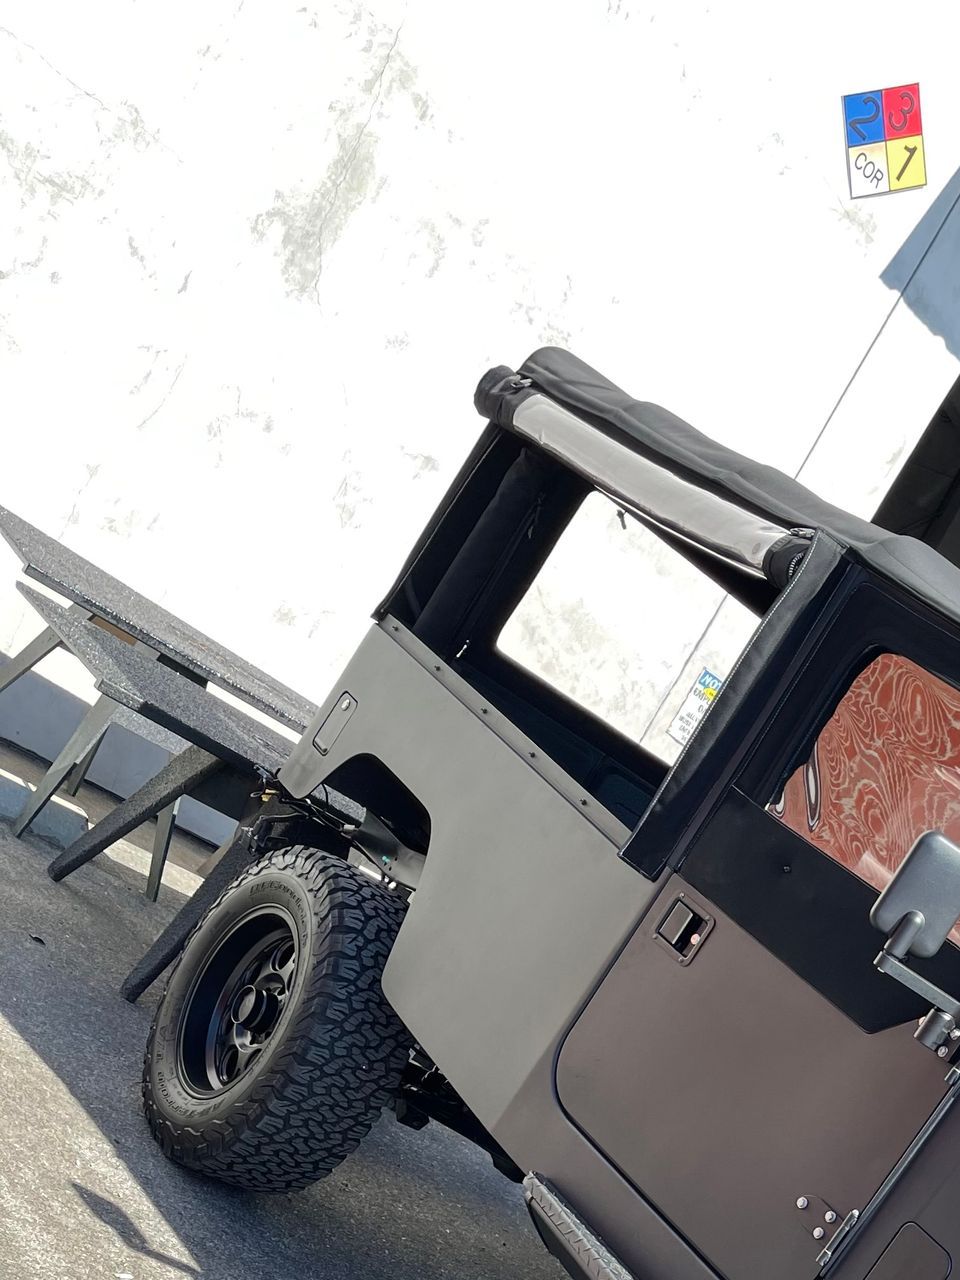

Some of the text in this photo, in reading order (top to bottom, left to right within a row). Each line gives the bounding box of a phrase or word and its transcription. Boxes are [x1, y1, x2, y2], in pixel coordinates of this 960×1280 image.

[848, 96, 881, 141] 2
[888, 91, 915, 132] 3
[854, 152, 884, 189] COR
[895, 144, 918, 182] 1
